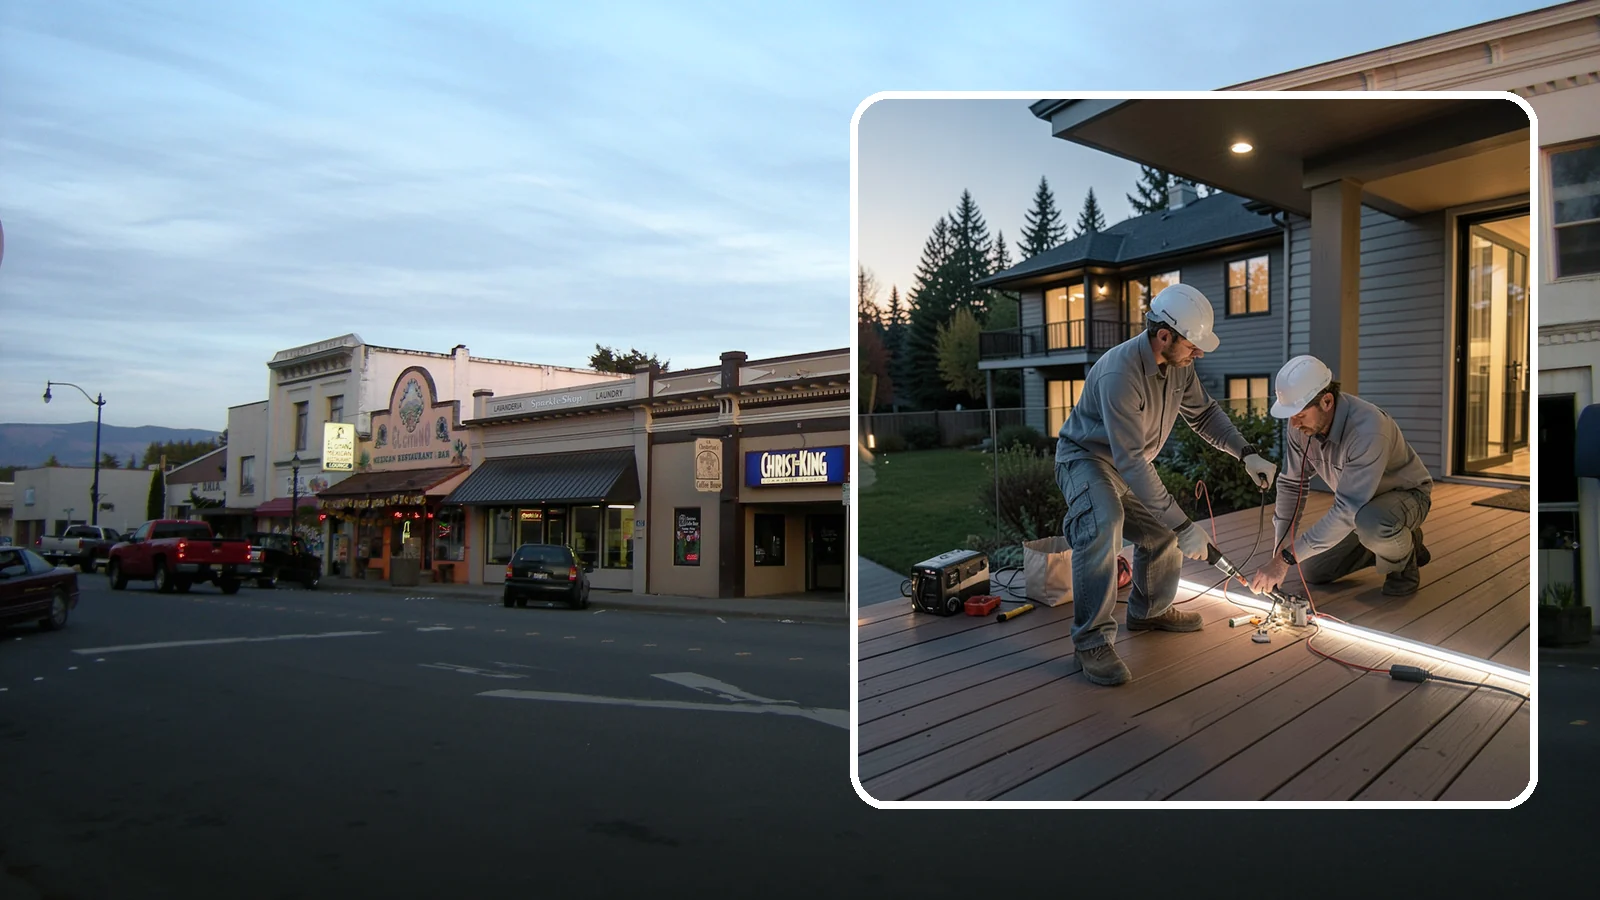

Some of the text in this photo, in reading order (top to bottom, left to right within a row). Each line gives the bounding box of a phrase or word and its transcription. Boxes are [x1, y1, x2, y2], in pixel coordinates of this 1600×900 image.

[493, 389, 624, 413] LAVANDERIA Sparkle Shop LAUNDRY
[373, 456, 396, 464] MEXICAN
[397, 452, 434, 462] RESTAURANT
[437, 450, 450, 458] BAR
[761, 450, 827, 477] CHRIST KING
